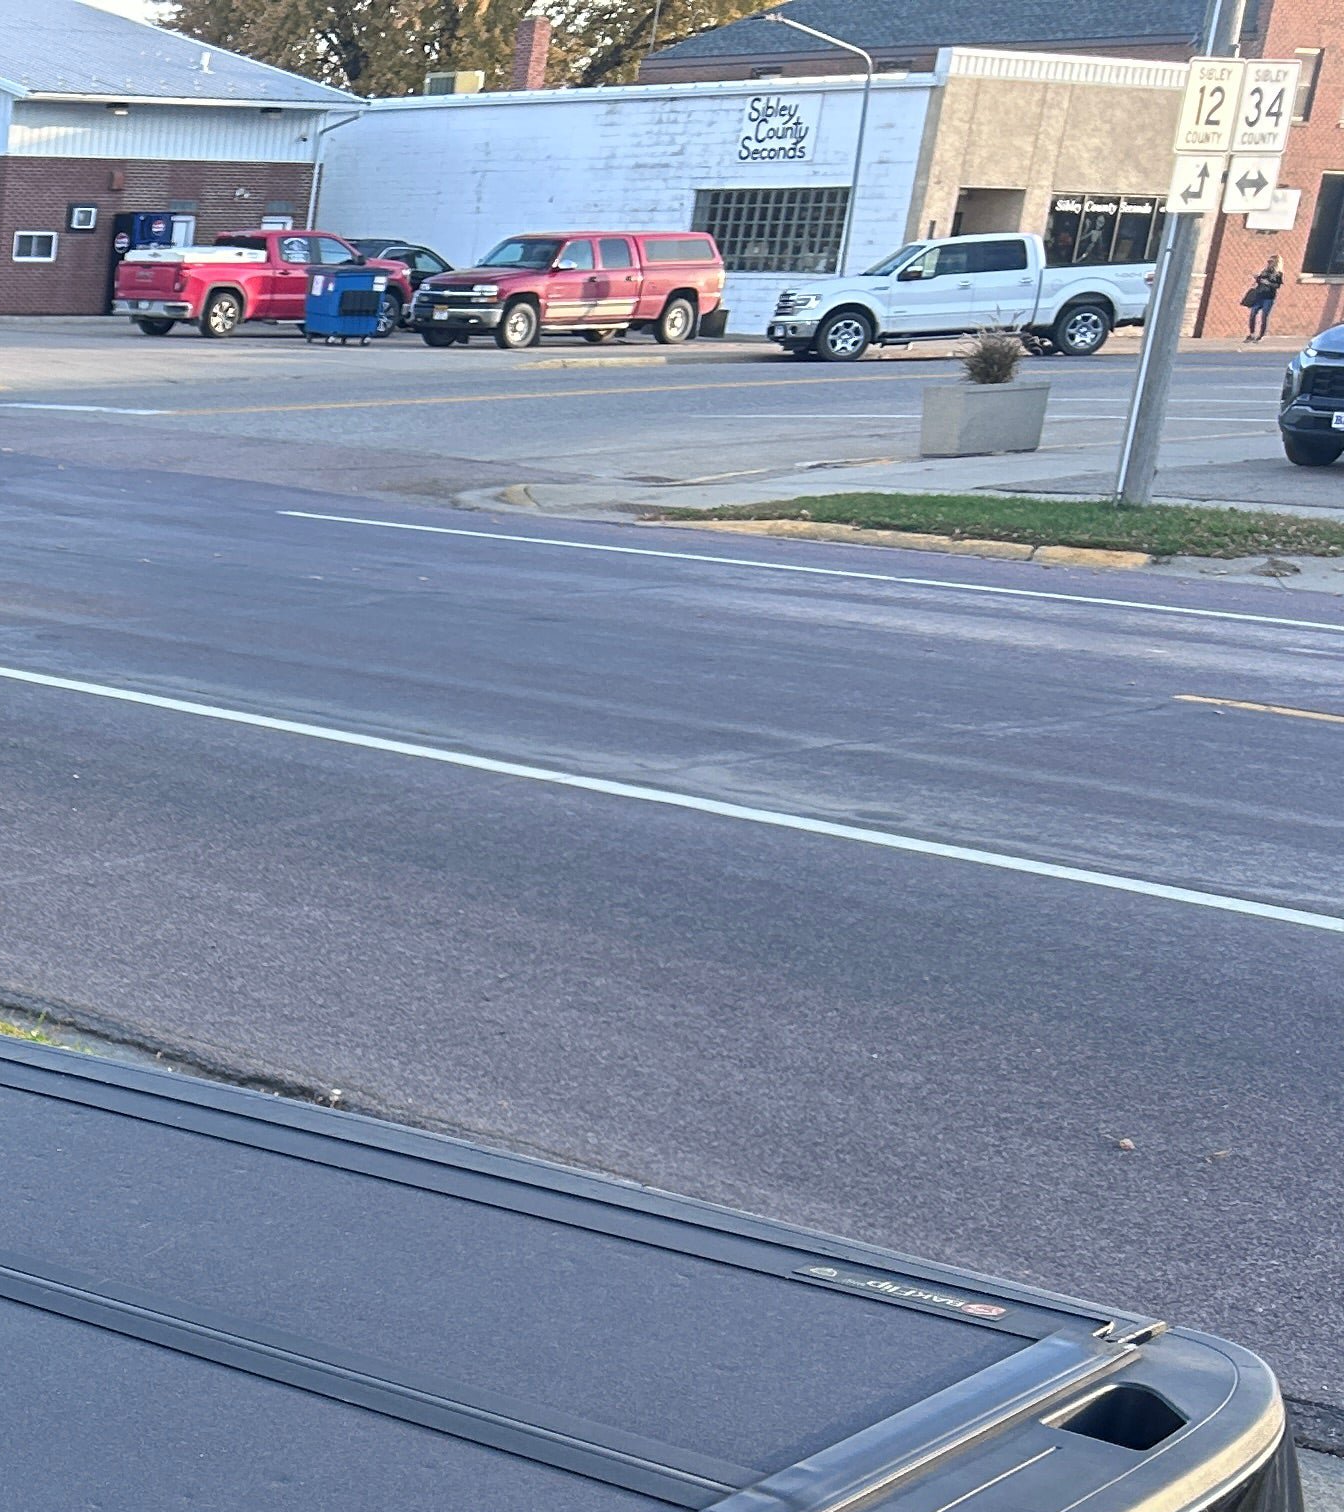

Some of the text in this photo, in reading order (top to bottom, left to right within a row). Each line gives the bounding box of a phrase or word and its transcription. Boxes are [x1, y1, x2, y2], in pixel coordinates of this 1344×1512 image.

[748, 97, 799, 126] Sibley
[1195, 85, 1226, 126] 12
[1245, 86, 1286, 128] 34
[755, 115, 810, 146] County
[1241, 132, 1279, 145] COUNTY
[738, 136, 806, 161] Seconds
